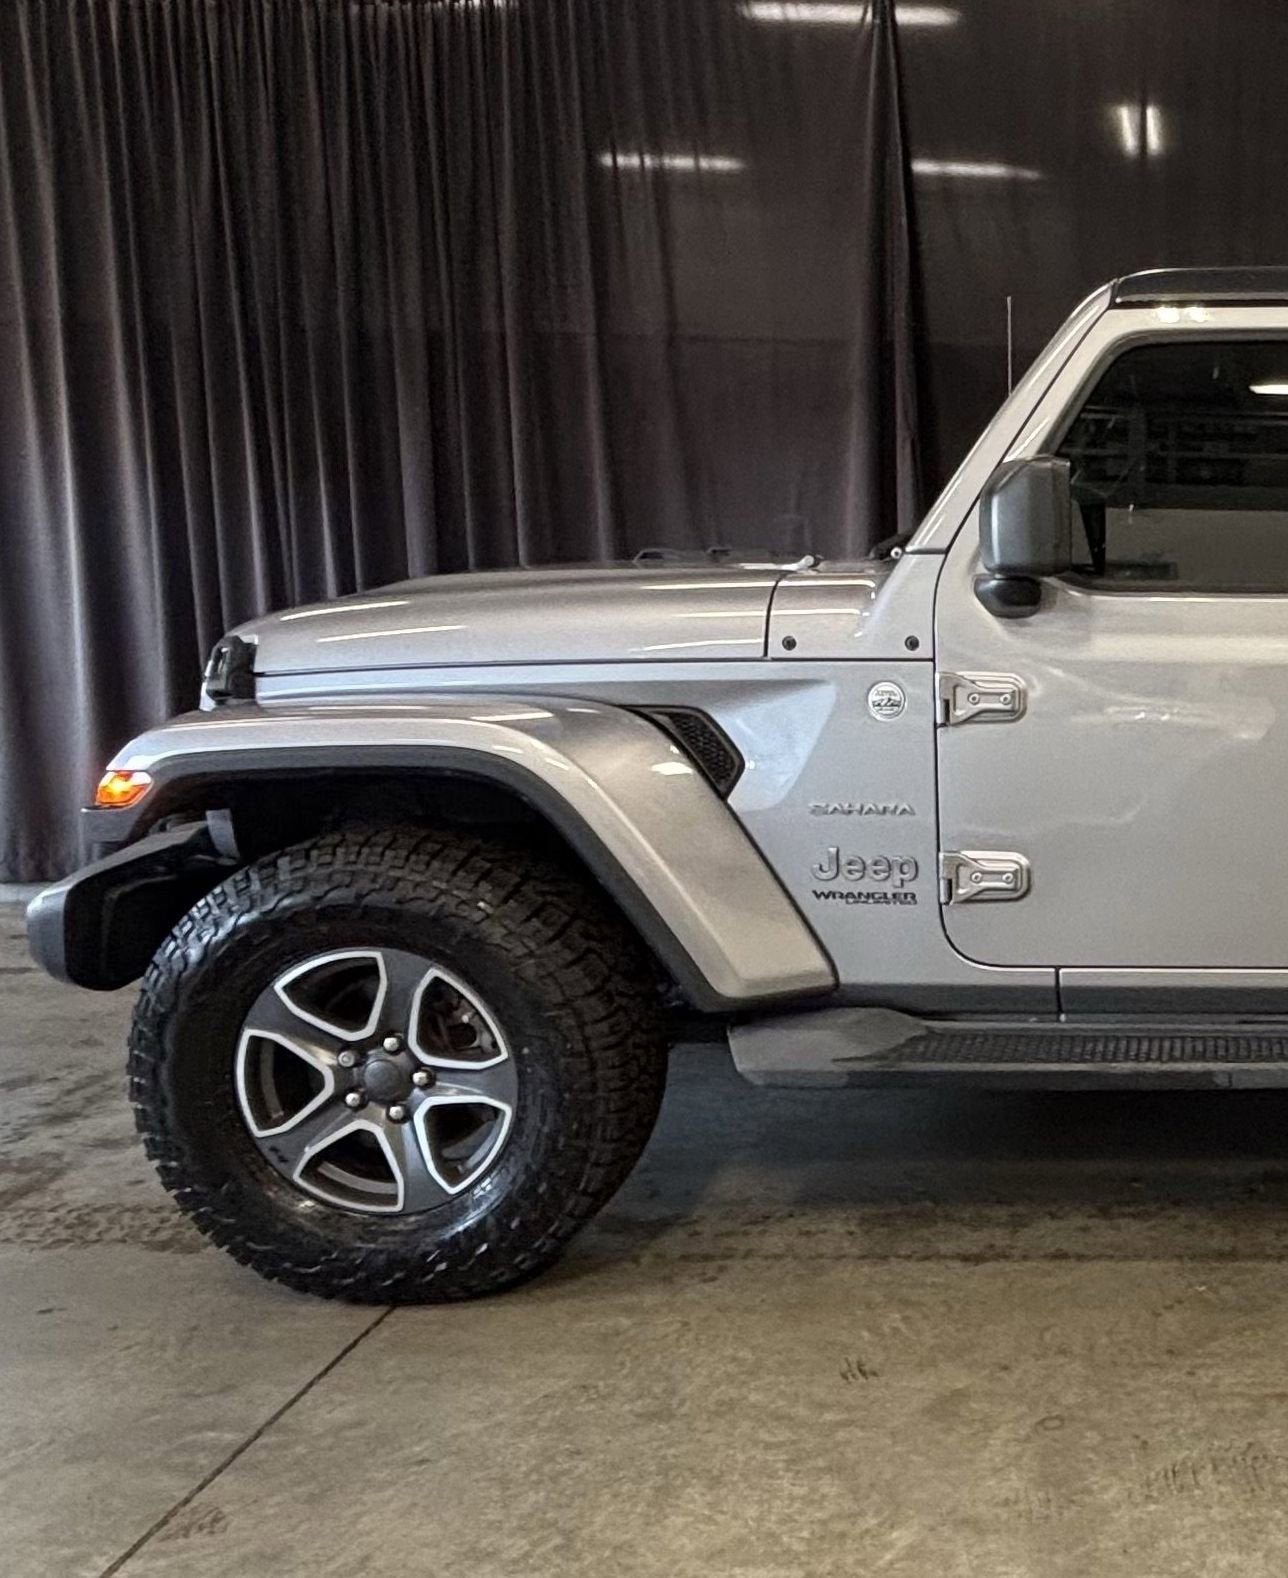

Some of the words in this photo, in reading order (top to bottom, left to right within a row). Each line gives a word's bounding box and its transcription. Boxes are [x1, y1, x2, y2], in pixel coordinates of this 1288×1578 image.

[808, 803, 916, 816] SAHARA
[811, 846, 919, 888] Jeep
[812, 890, 917, 901] WRANGLER
